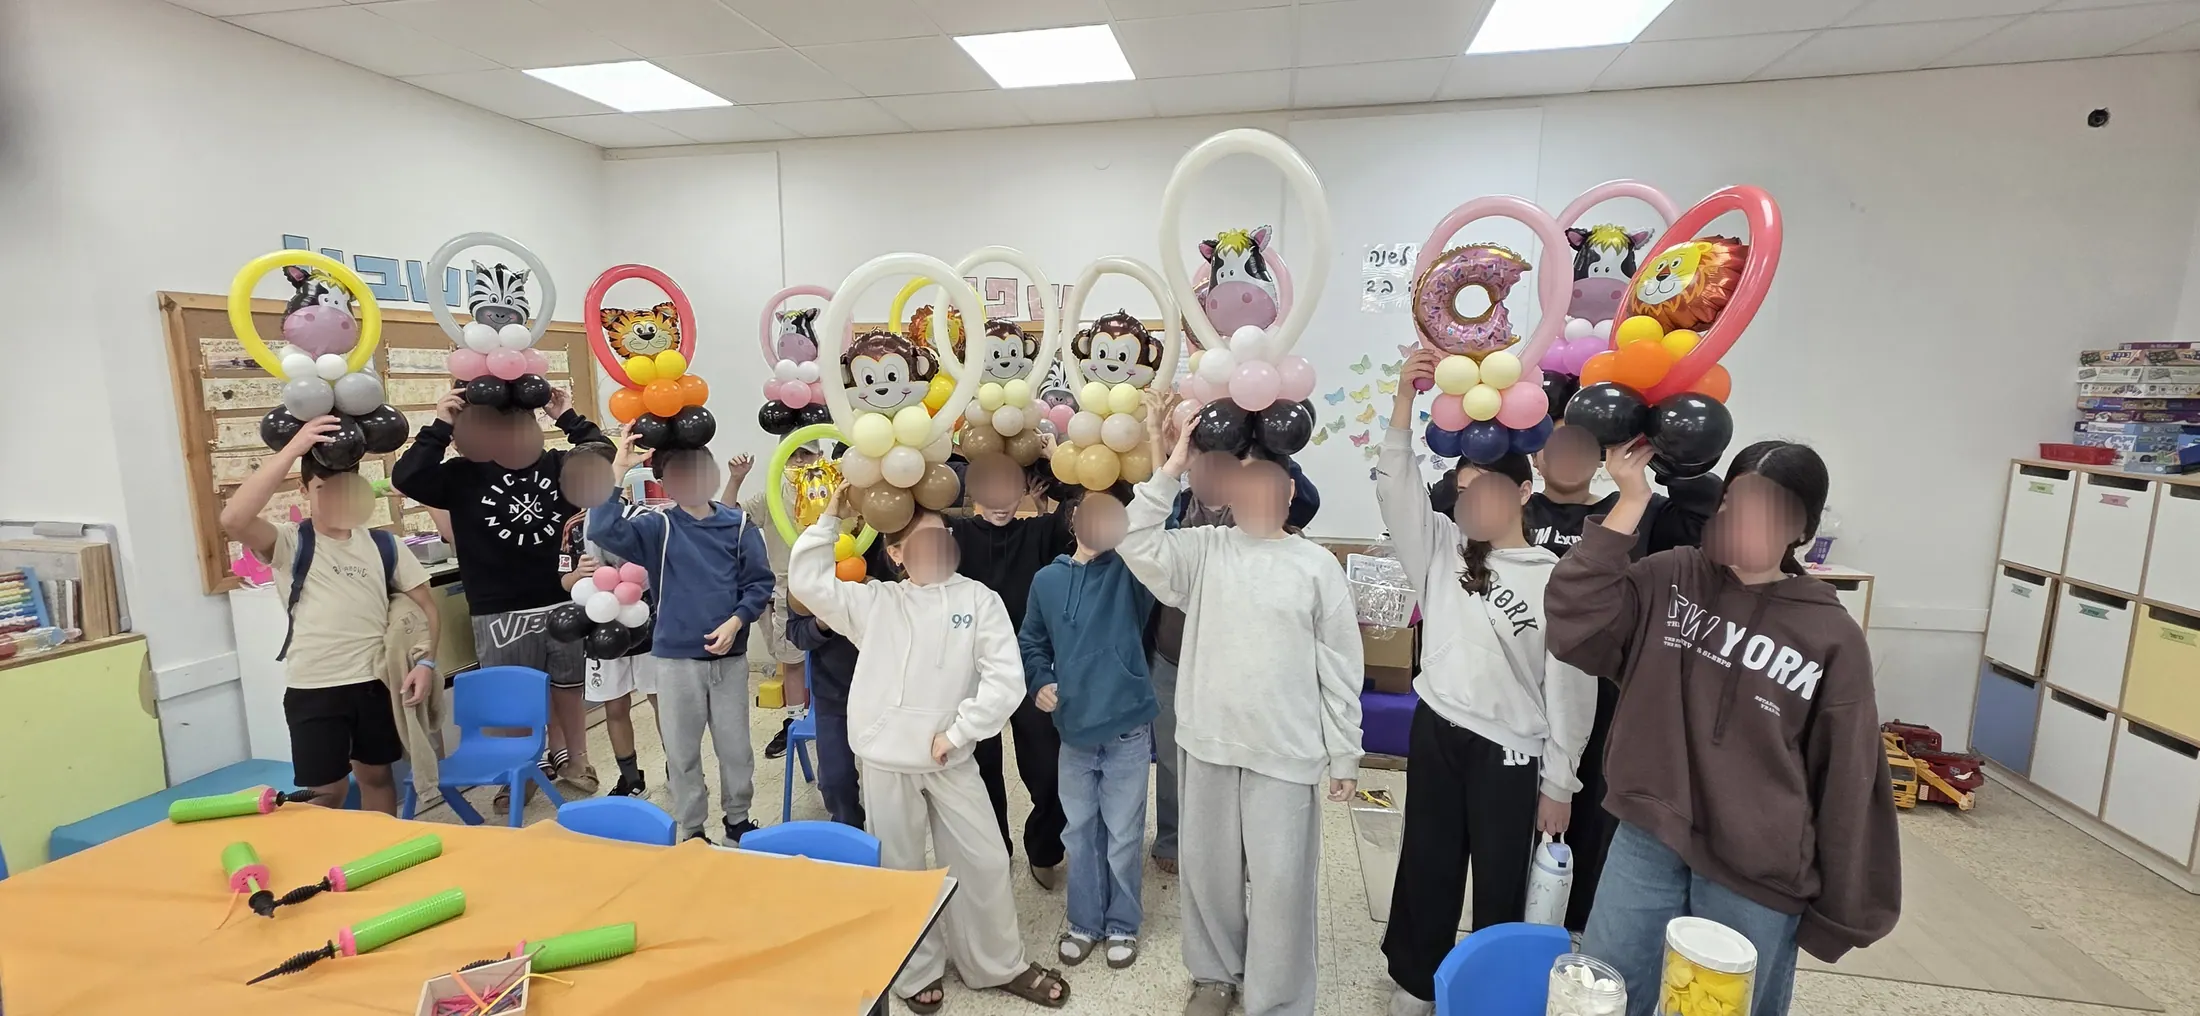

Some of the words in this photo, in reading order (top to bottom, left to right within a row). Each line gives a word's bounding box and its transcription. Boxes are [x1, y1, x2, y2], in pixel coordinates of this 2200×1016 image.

[1369, 246, 1410, 267] לשנה
[481, 471, 559, 506] FICION
[951, 614, 973, 629] 99
[1485, 582, 1539, 637] YORK
[490, 612, 549, 649] VIB
[1719, 621, 1824, 701] YORK
